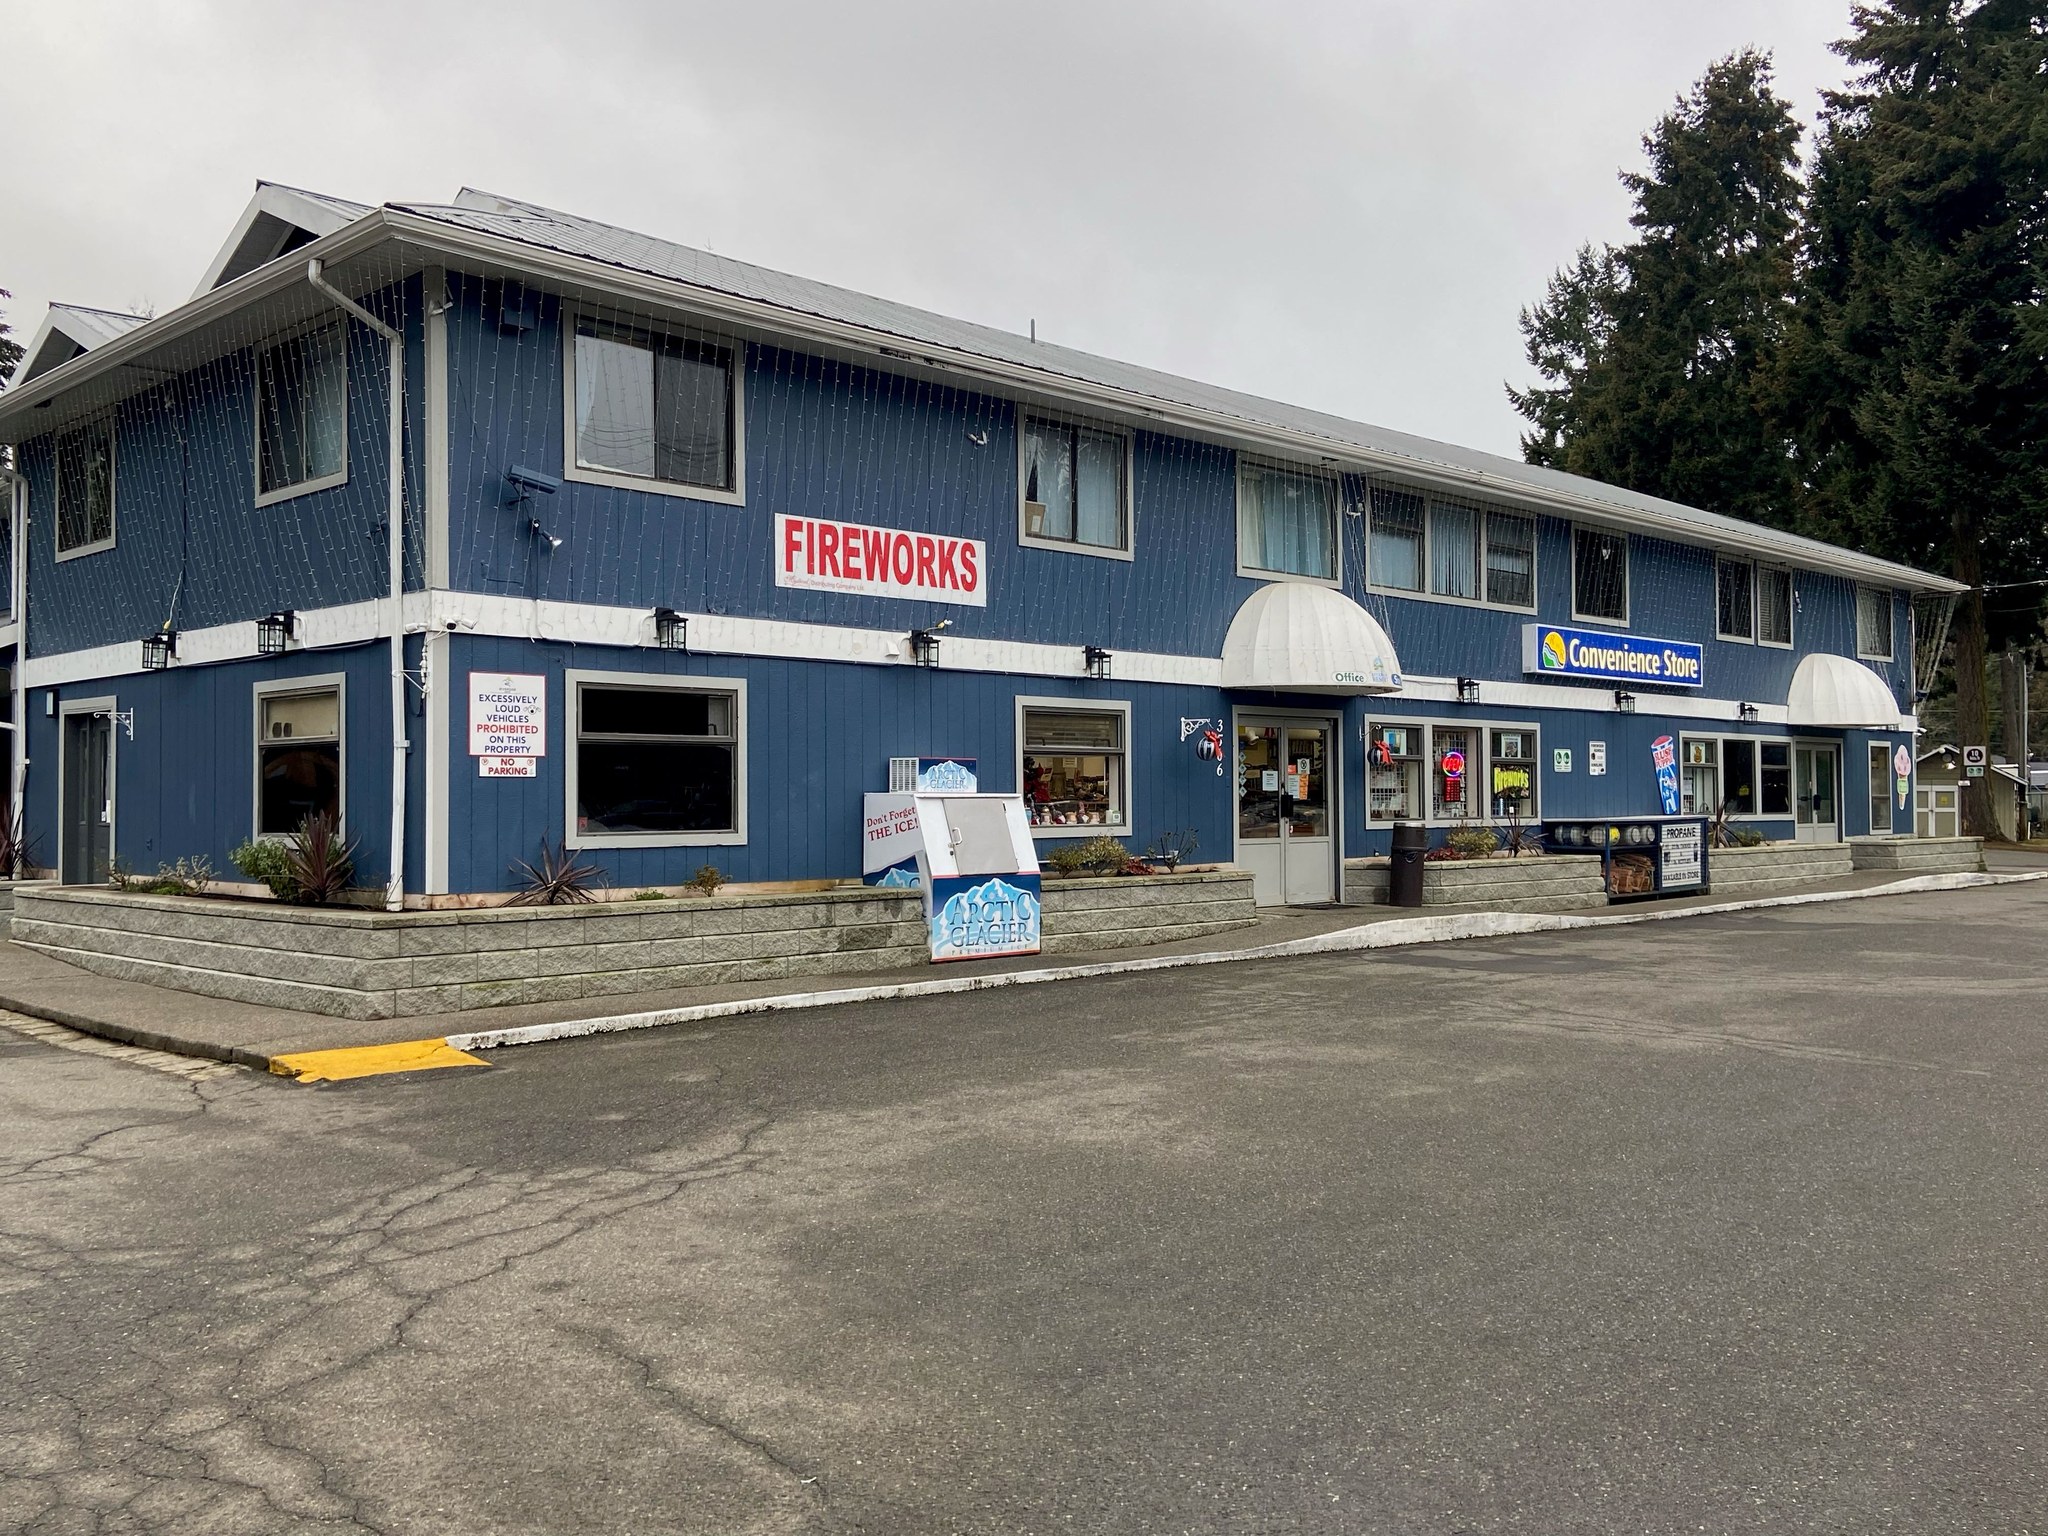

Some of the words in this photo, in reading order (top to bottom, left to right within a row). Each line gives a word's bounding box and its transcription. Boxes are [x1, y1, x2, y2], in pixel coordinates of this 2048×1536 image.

[785, 519, 977, 592] FIREWORKS
[1569, 638, 1661, 675] Convenience
[1663, 649, 1698, 679] Store
[1335, 673, 1364, 683] Office
[478, 694, 538, 704] EXCESSIVELY
[495, 705, 520, 713] LOUD
[486, 714, 529, 723] VEHICLES
[476, 724, 538, 734] PROHIBITED
[489, 735, 504, 744] ON
[506, 736, 526, 744] THIS
[484, 745, 531, 753] PROPERTY
[500, 758, 515, 766] NO
[488, 767, 528, 775] PARKING
[930, 767, 966, 780] ARCTIC
[930, 780, 965, 789] GLACIER
[867, 814, 888, 827] Don't
[889, 806, 916, 821] Forget
[868, 825, 892, 841] THE
[895, 819, 919, 834] ICE!
[1667, 827, 1696, 838] PROPANE
[1687, 871, 1699, 879] STORE
[950, 892, 1031, 925] ARCTIC
[950, 922, 1030, 948] GLACIER
[951, 946, 1003, 956] PREMIUM
